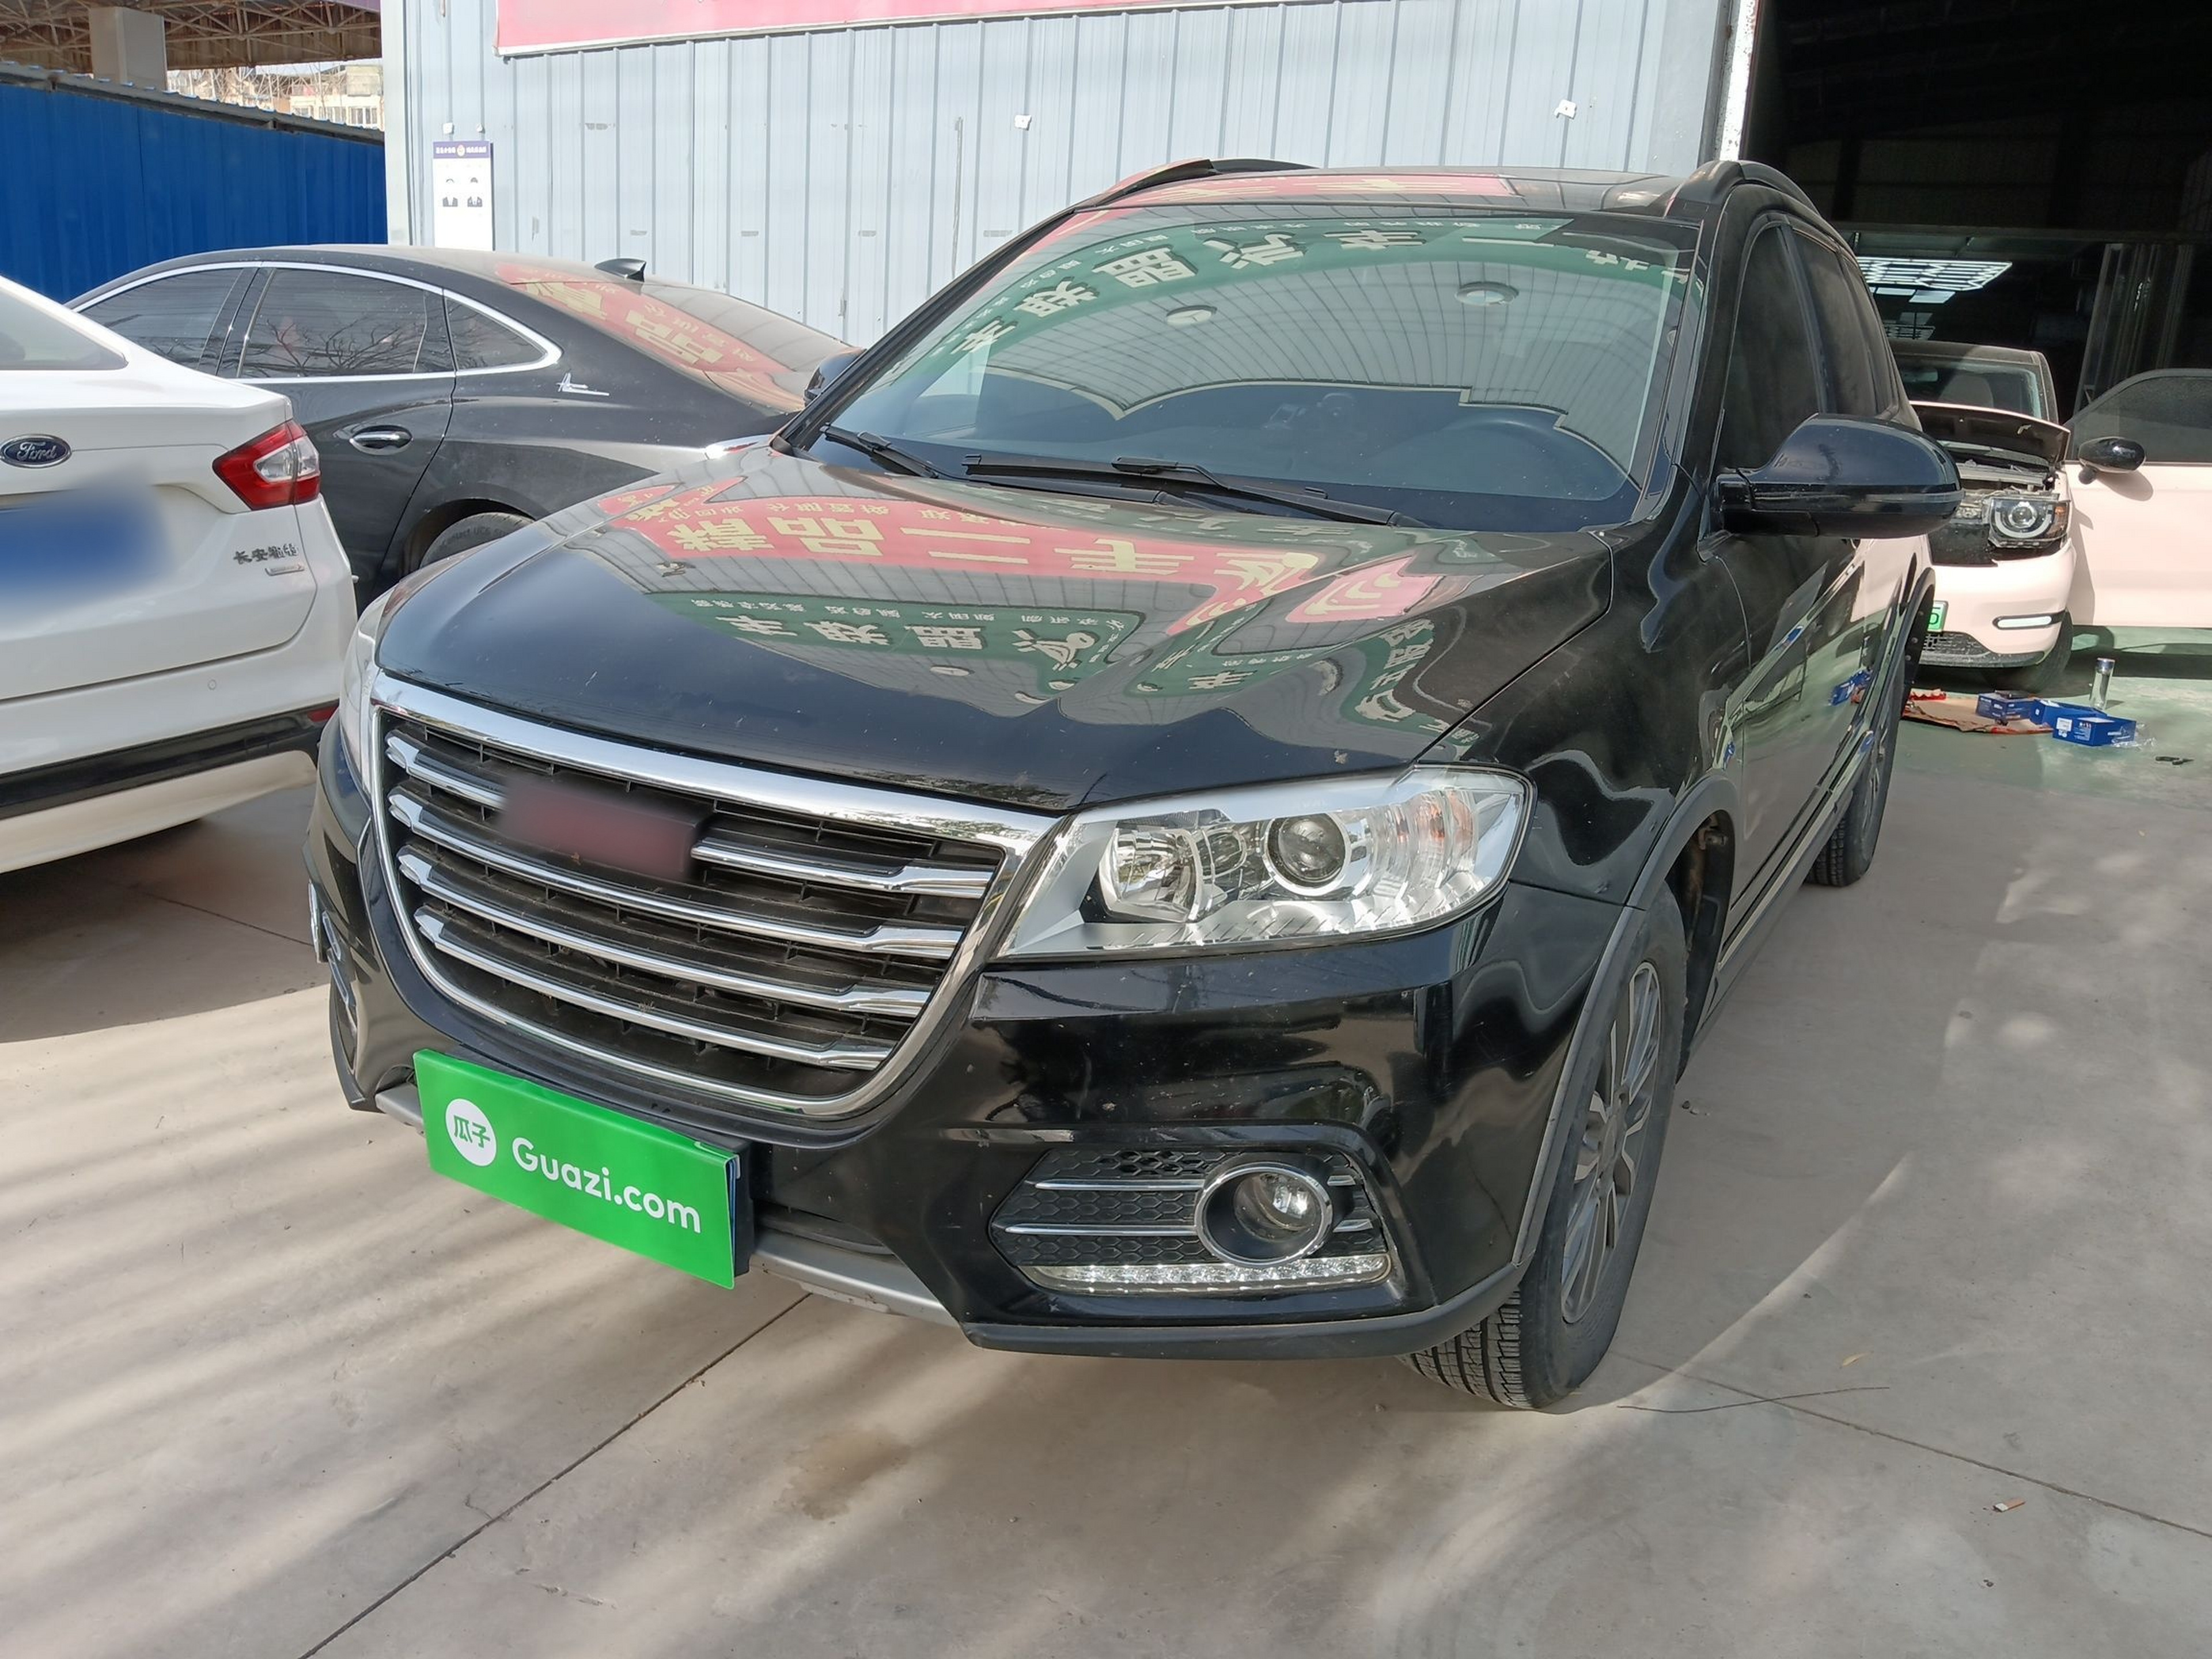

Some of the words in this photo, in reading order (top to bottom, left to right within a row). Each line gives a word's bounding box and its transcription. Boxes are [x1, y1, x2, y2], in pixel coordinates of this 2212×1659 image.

[17, 441, 56, 461] Ford
[453, 1115, 490, 1148] 瓜子
[513, 1137, 701, 1234] Guazi.com
